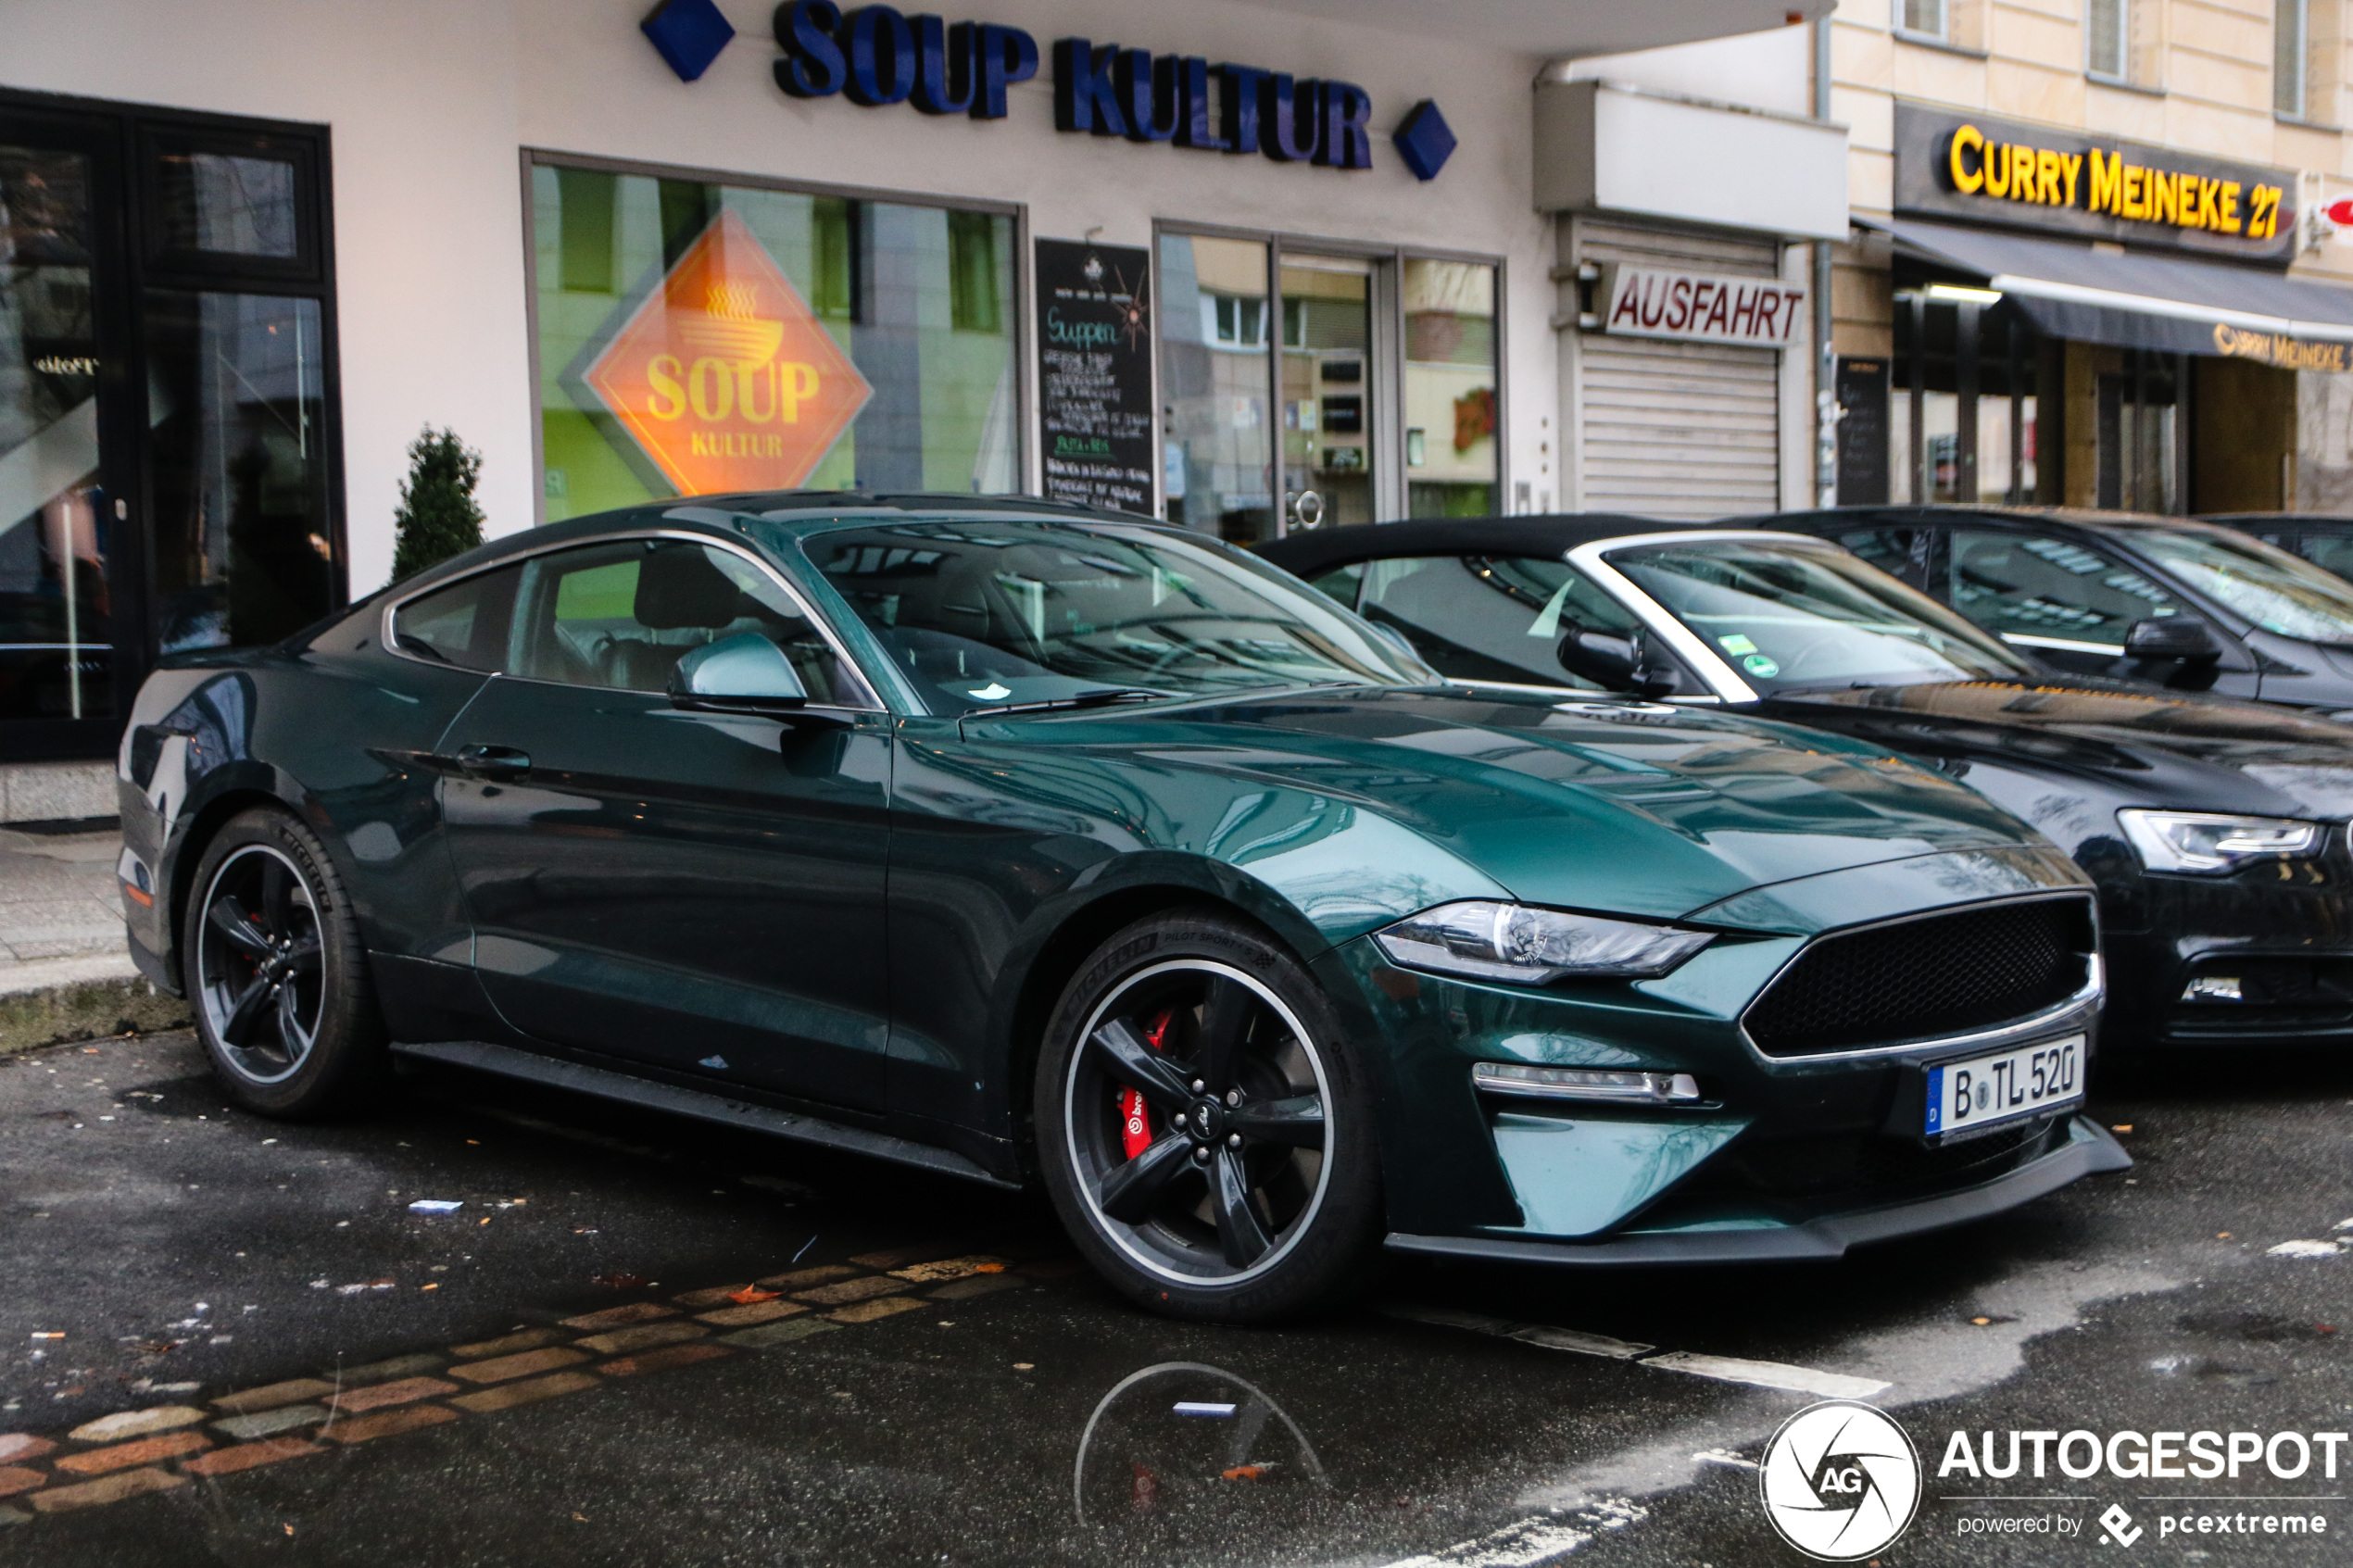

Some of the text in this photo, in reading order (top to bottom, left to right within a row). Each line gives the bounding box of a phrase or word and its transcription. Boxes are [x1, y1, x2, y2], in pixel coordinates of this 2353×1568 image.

[773, 0, 1373, 169] SOUP KULTUR
[2247, 182, 2283, 239] 27
[1613, 274, 1804, 340] AUSFAHRT
[647, 354, 820, 424] SOUP
[692, 431, 782, 458] KULTUR
[1164, 932, 1196, 943] PILOT
[1199, 932, 1236, 948] SPORT
[1067, 935, 1151, 1016] MICHELIN
[1955, 1045, 2074, 1120] B TL 520
